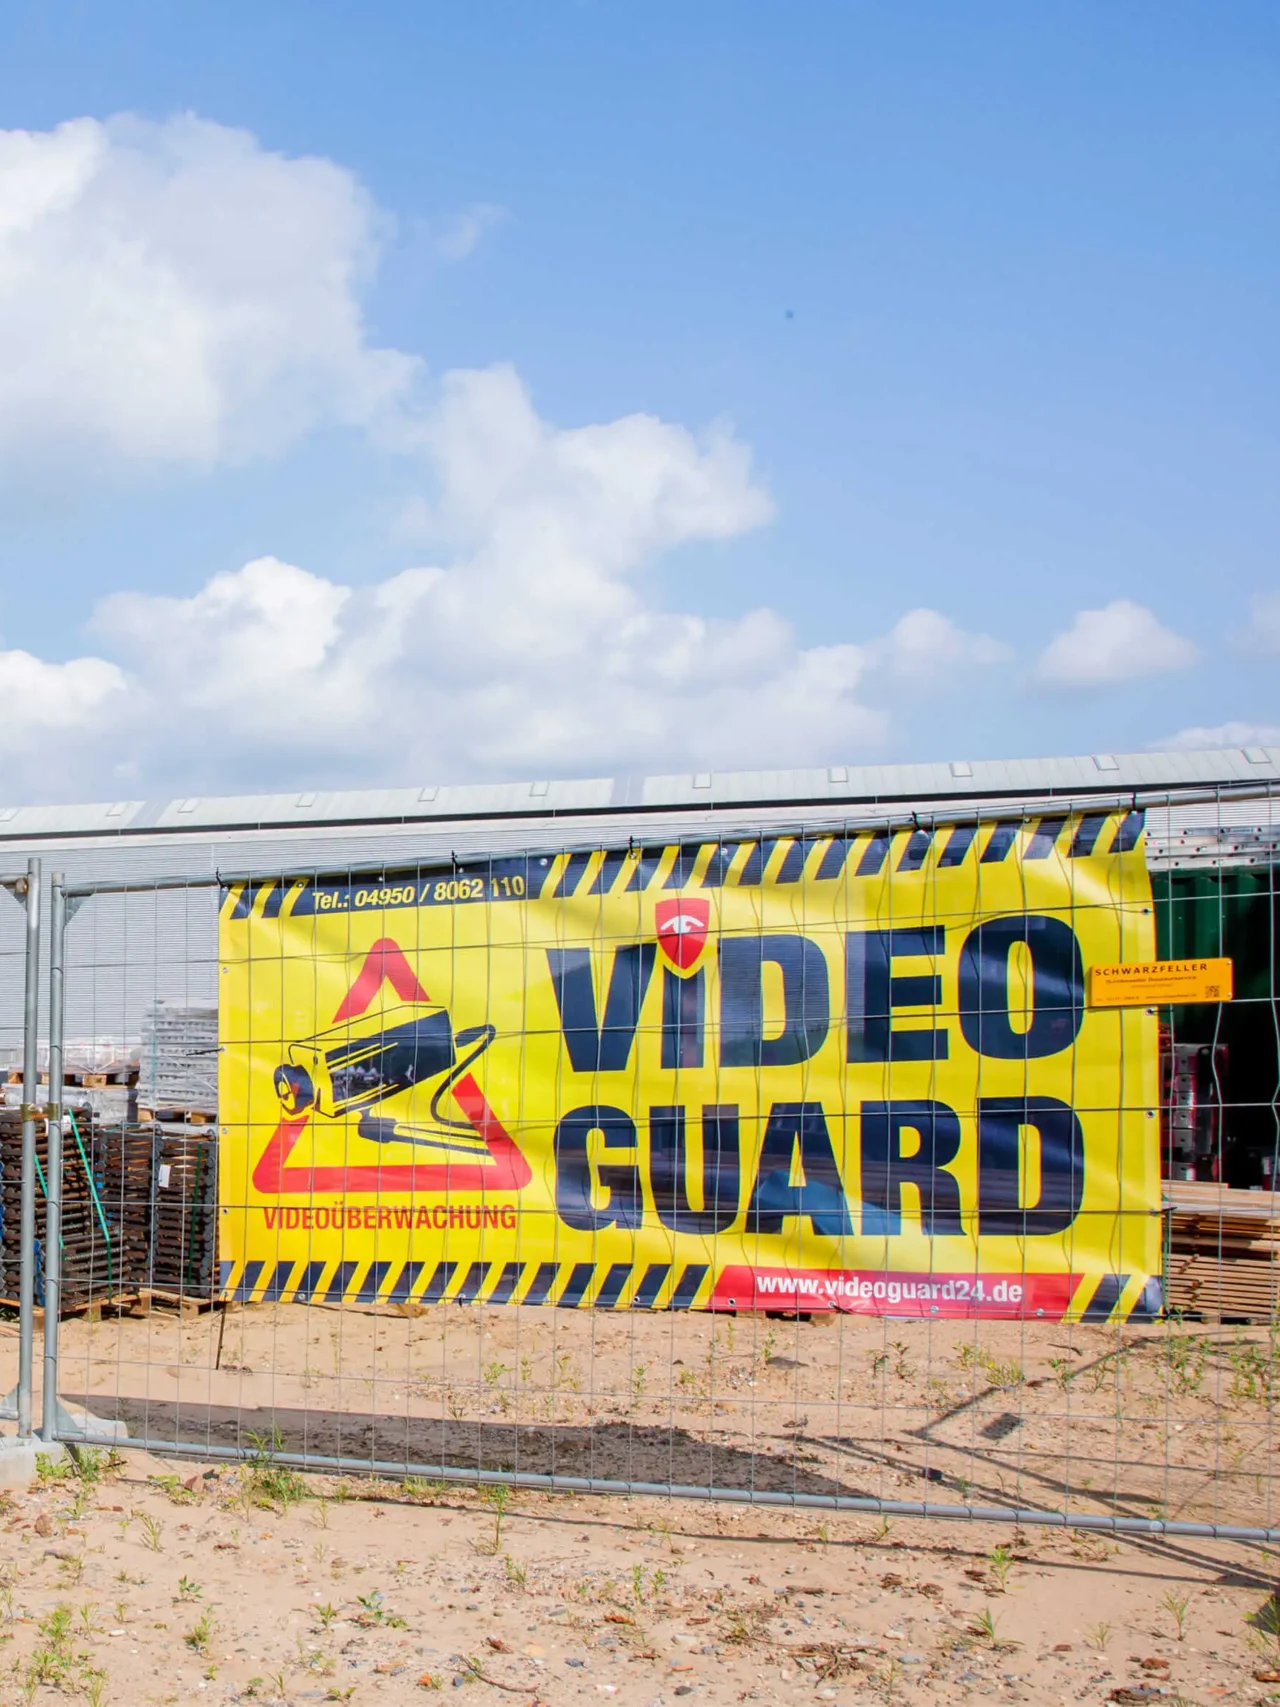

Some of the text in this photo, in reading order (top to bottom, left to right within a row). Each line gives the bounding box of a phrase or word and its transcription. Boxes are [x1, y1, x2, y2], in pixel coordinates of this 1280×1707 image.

[312, 876, 525, 910] Tel.: 04950 / 8062 110
[1095, 963, 1208, 977] SCHWARZFELLER
[545, 914, 1085, 1073] VIDEO
[553, 1096, 1085, 1237] GUARD
[263, 1201, 517, 1230] VIDEOÜBERWACHUNG
[756, 1275, 1023, 1304] www.videoguard24.de
